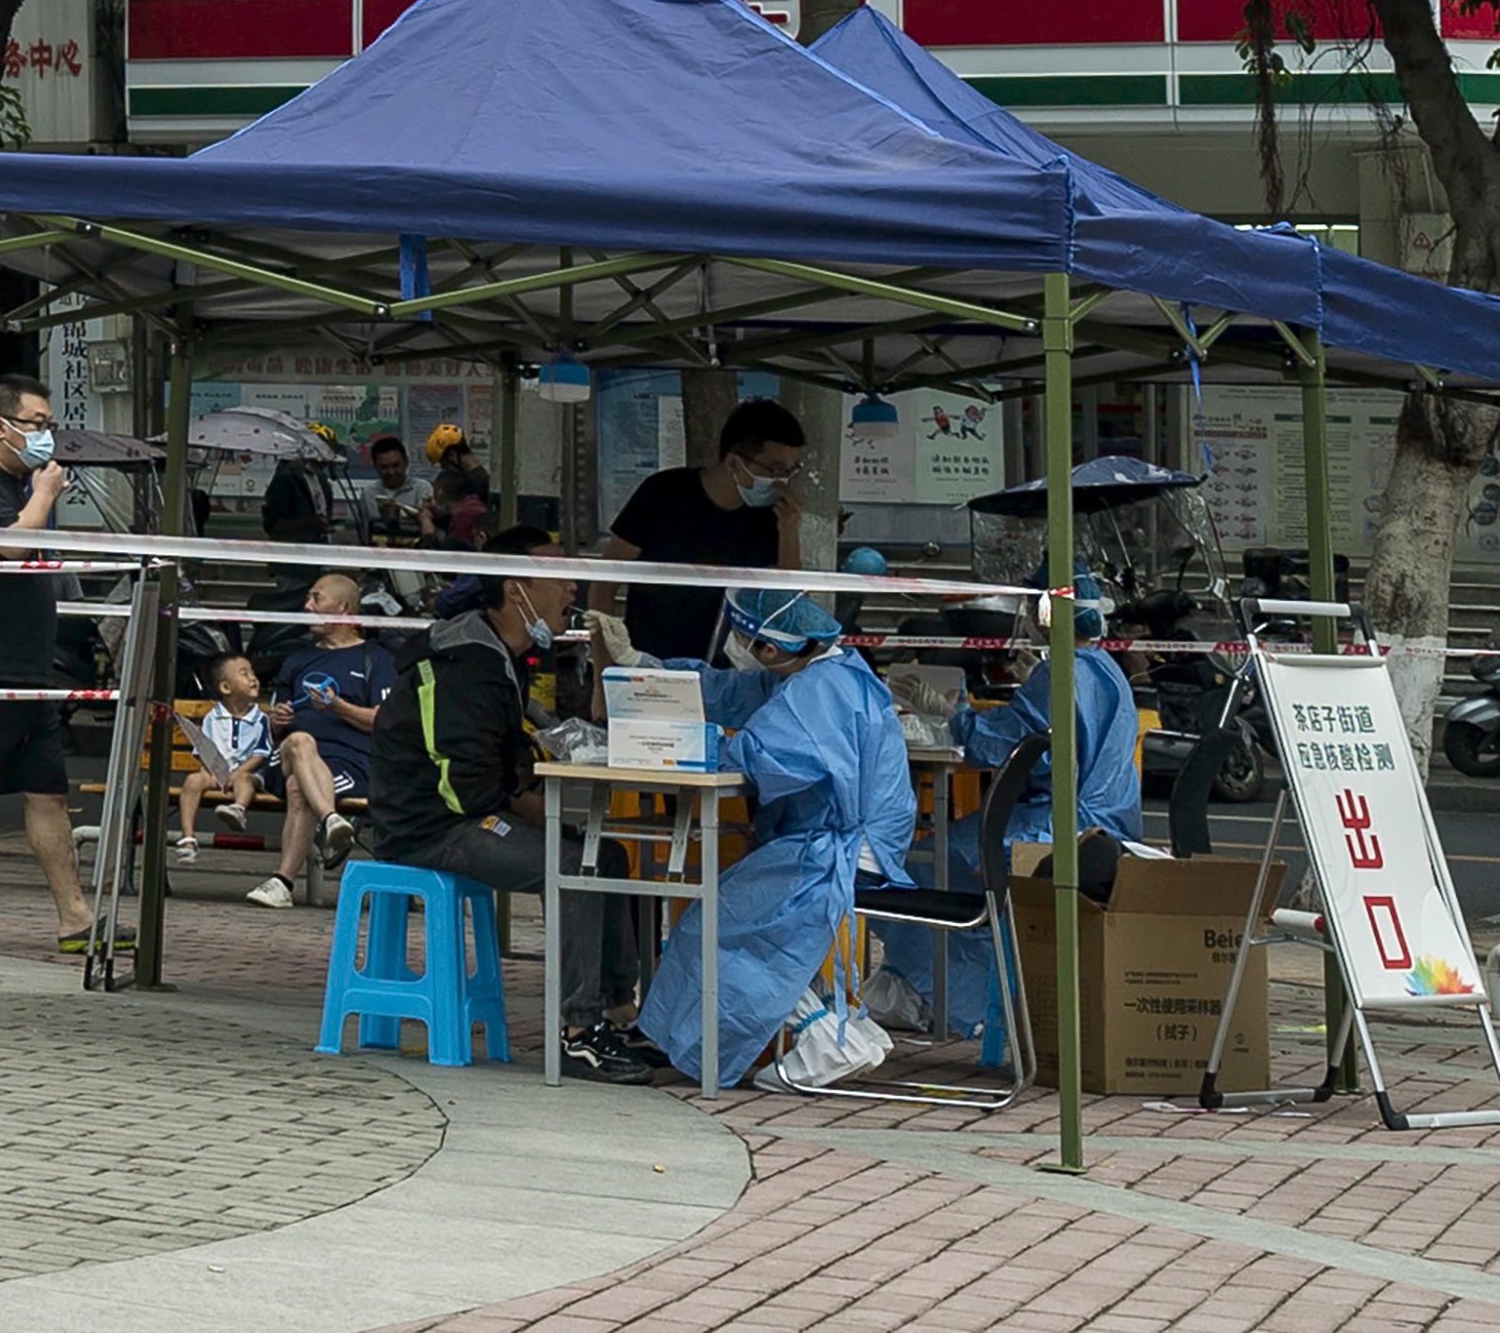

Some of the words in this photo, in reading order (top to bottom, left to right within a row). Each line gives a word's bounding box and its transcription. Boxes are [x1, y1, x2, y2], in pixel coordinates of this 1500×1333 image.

[1292, 703, 1376, 733] 茶店子街道
[1296, 741, 1395, 772] 应急核酸检测
[1334, 788, 1413, 971] 出口
